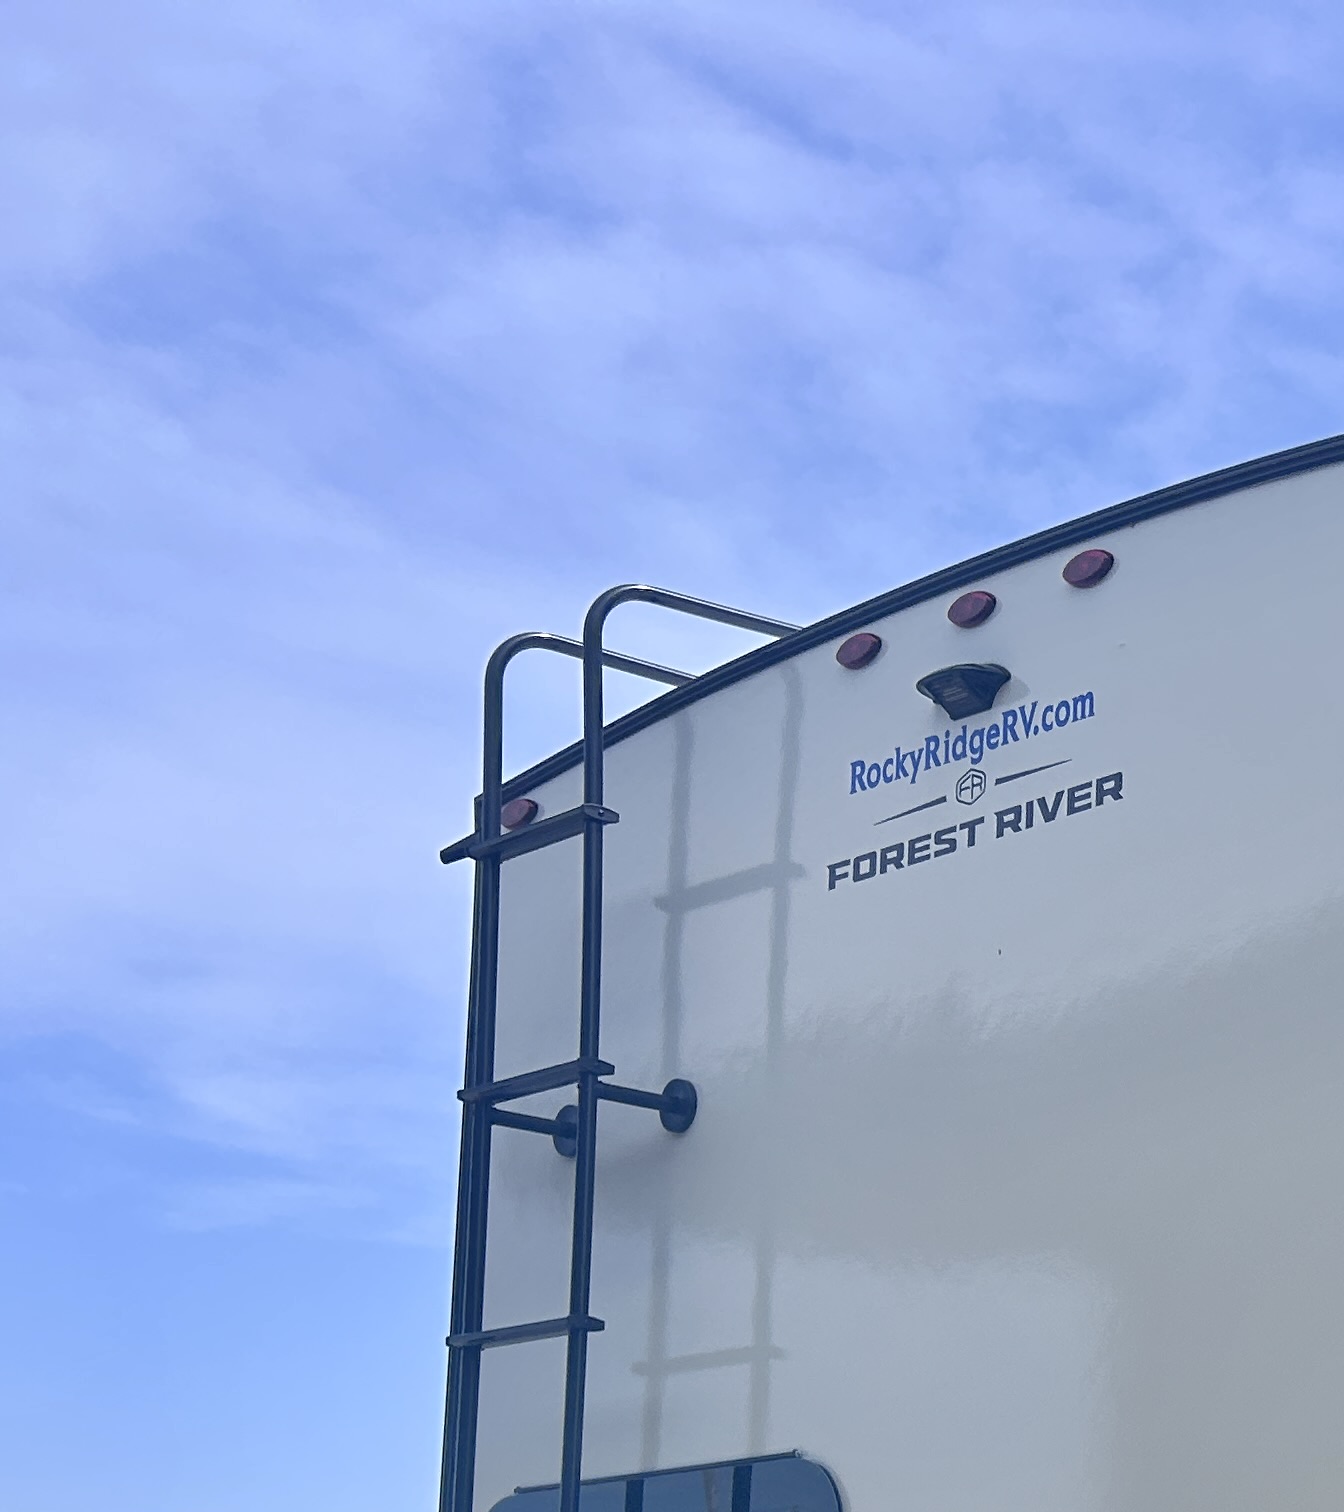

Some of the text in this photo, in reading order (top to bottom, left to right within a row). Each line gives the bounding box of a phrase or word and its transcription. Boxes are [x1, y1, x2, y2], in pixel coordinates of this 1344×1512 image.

[849, 691, 1095, 794] RockyRidgeRV.com
[827, 771, 1124, 891] FOREST RIVER
